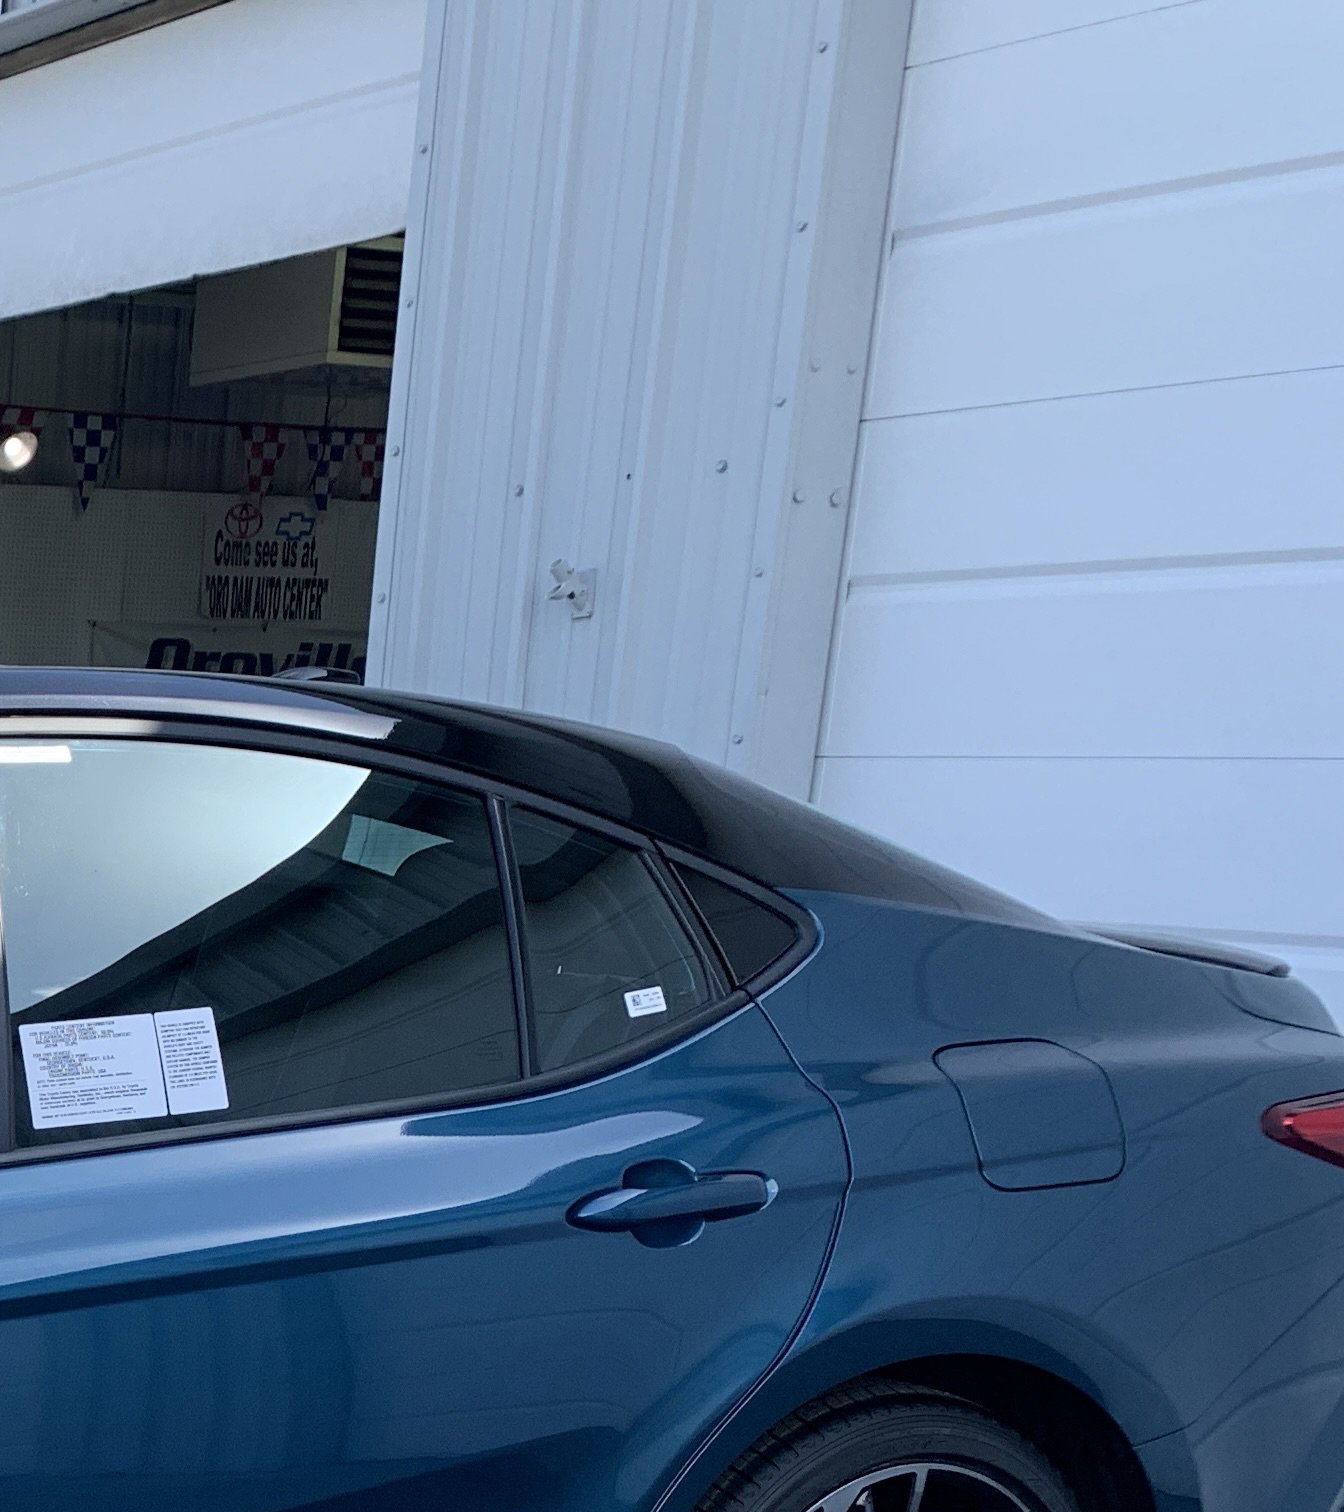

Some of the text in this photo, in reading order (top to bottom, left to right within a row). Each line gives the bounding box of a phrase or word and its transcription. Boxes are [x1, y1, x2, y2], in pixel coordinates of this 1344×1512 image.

[214, 529, 320, 576] Come see us at,
[231, 576, 253, 619] DAM
[253, 576, 282, 620] AUTO
